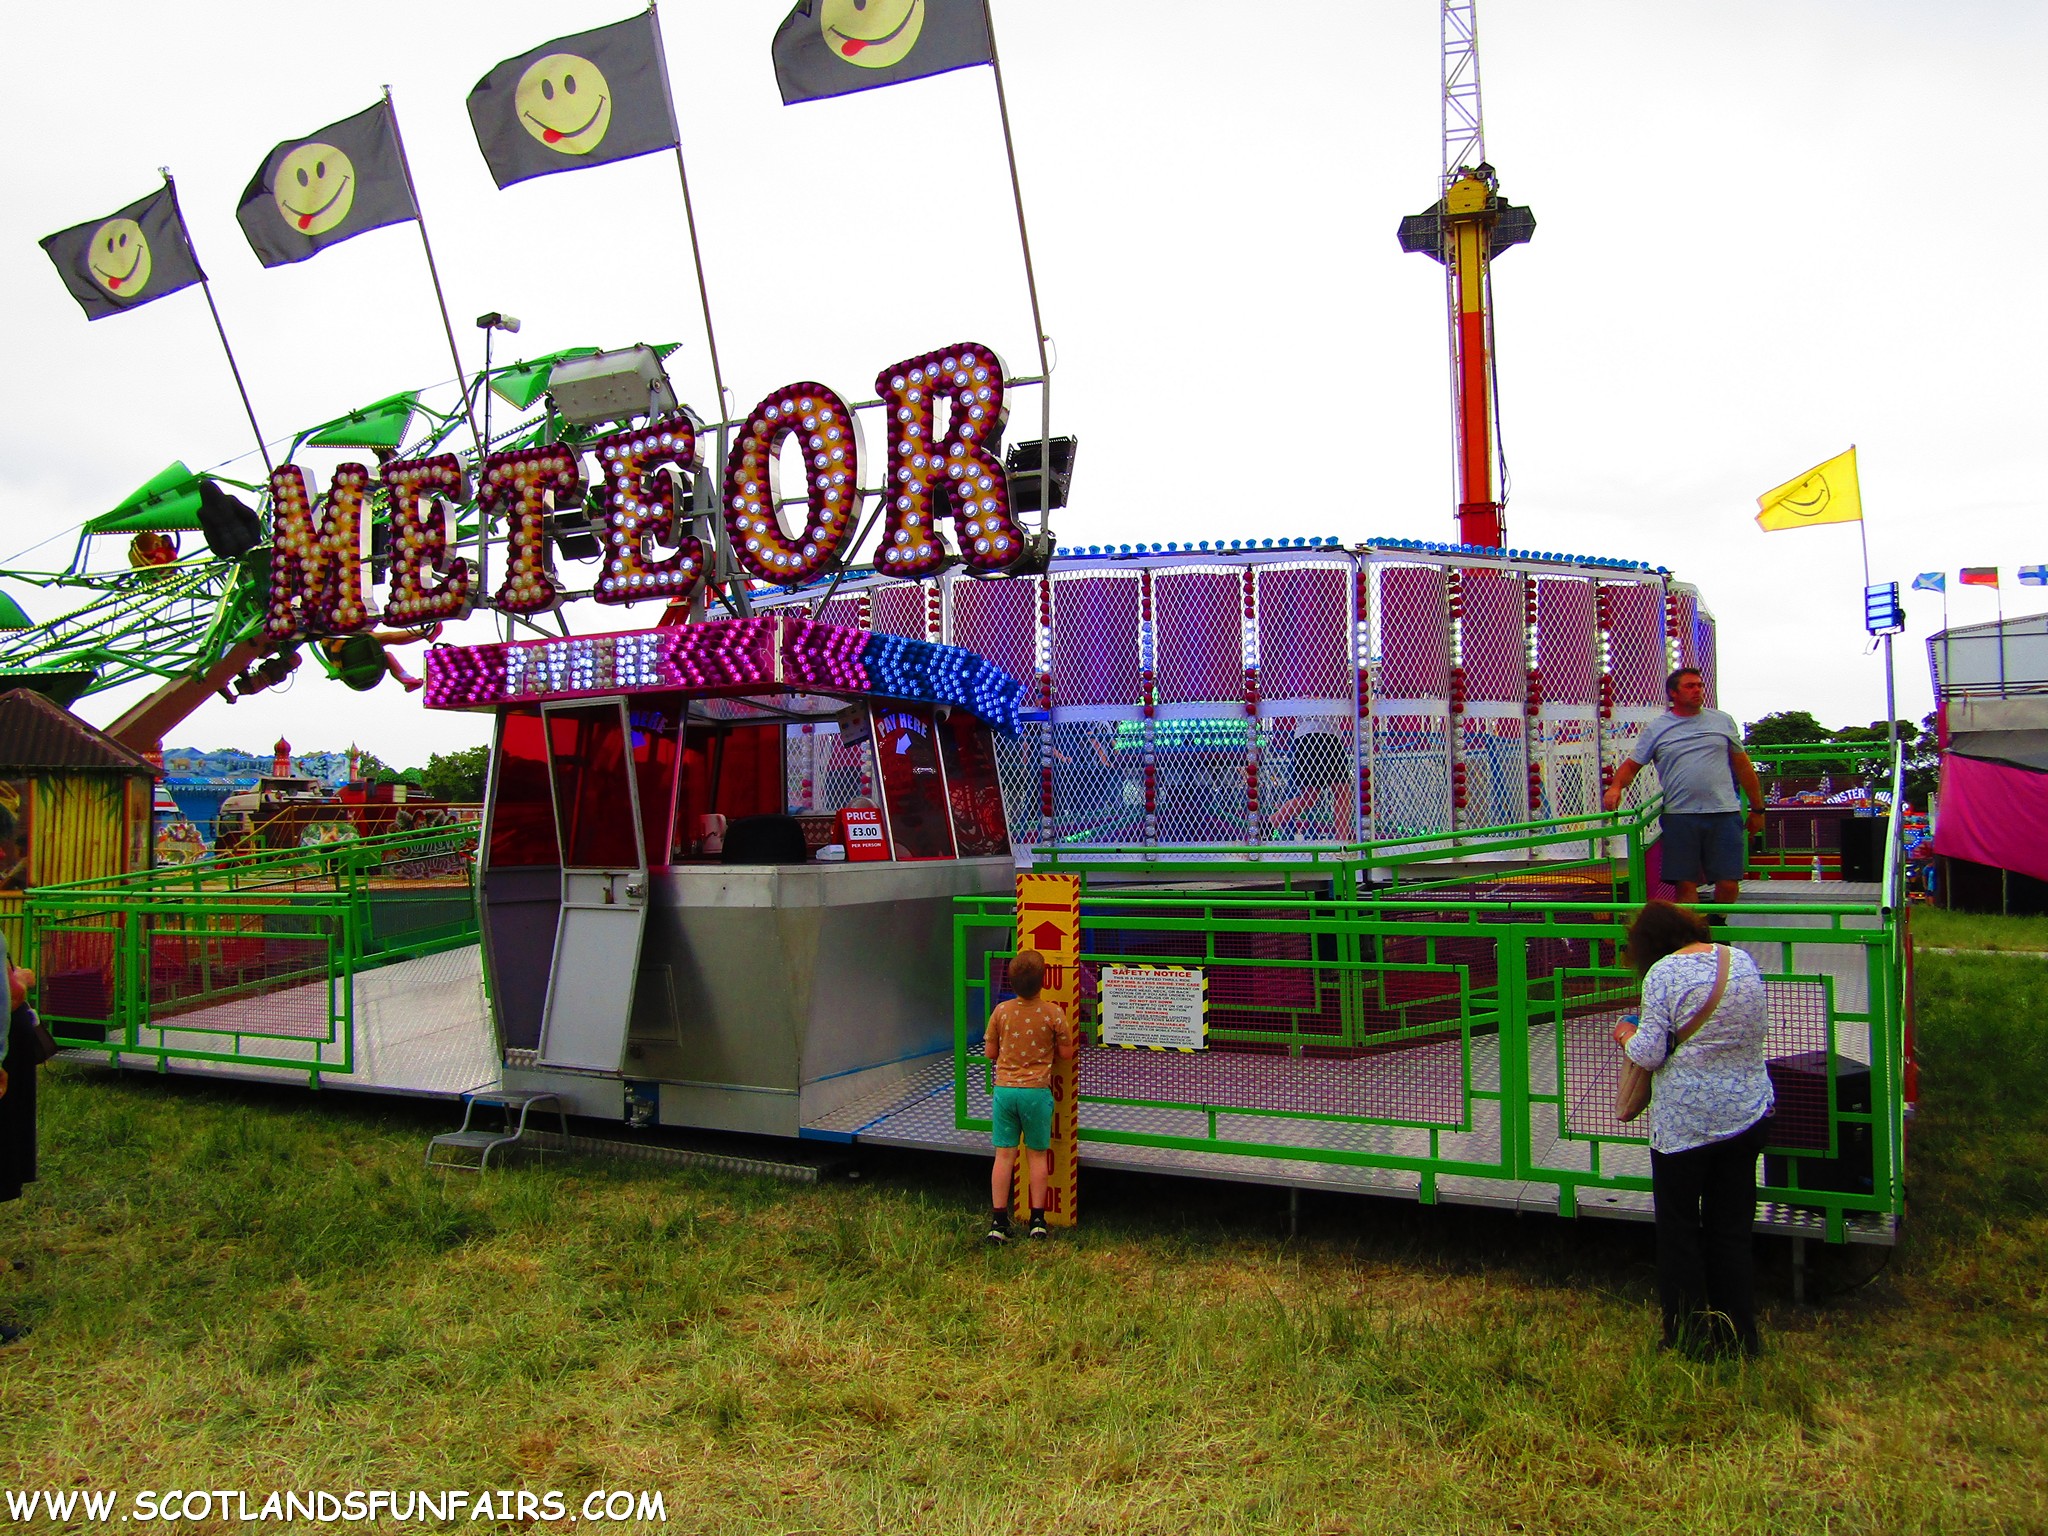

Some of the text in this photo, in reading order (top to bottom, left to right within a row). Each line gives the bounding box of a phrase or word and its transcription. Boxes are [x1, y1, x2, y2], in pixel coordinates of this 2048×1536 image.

[269, 342, 1027, 641] METEOR
[877, 712, 928, 739] PAY HERE
[1823, 787, 1866, 805] ONSTER
[846, 811, 877, 820] PRICE
[852, 827, 877, 836] £3.00
